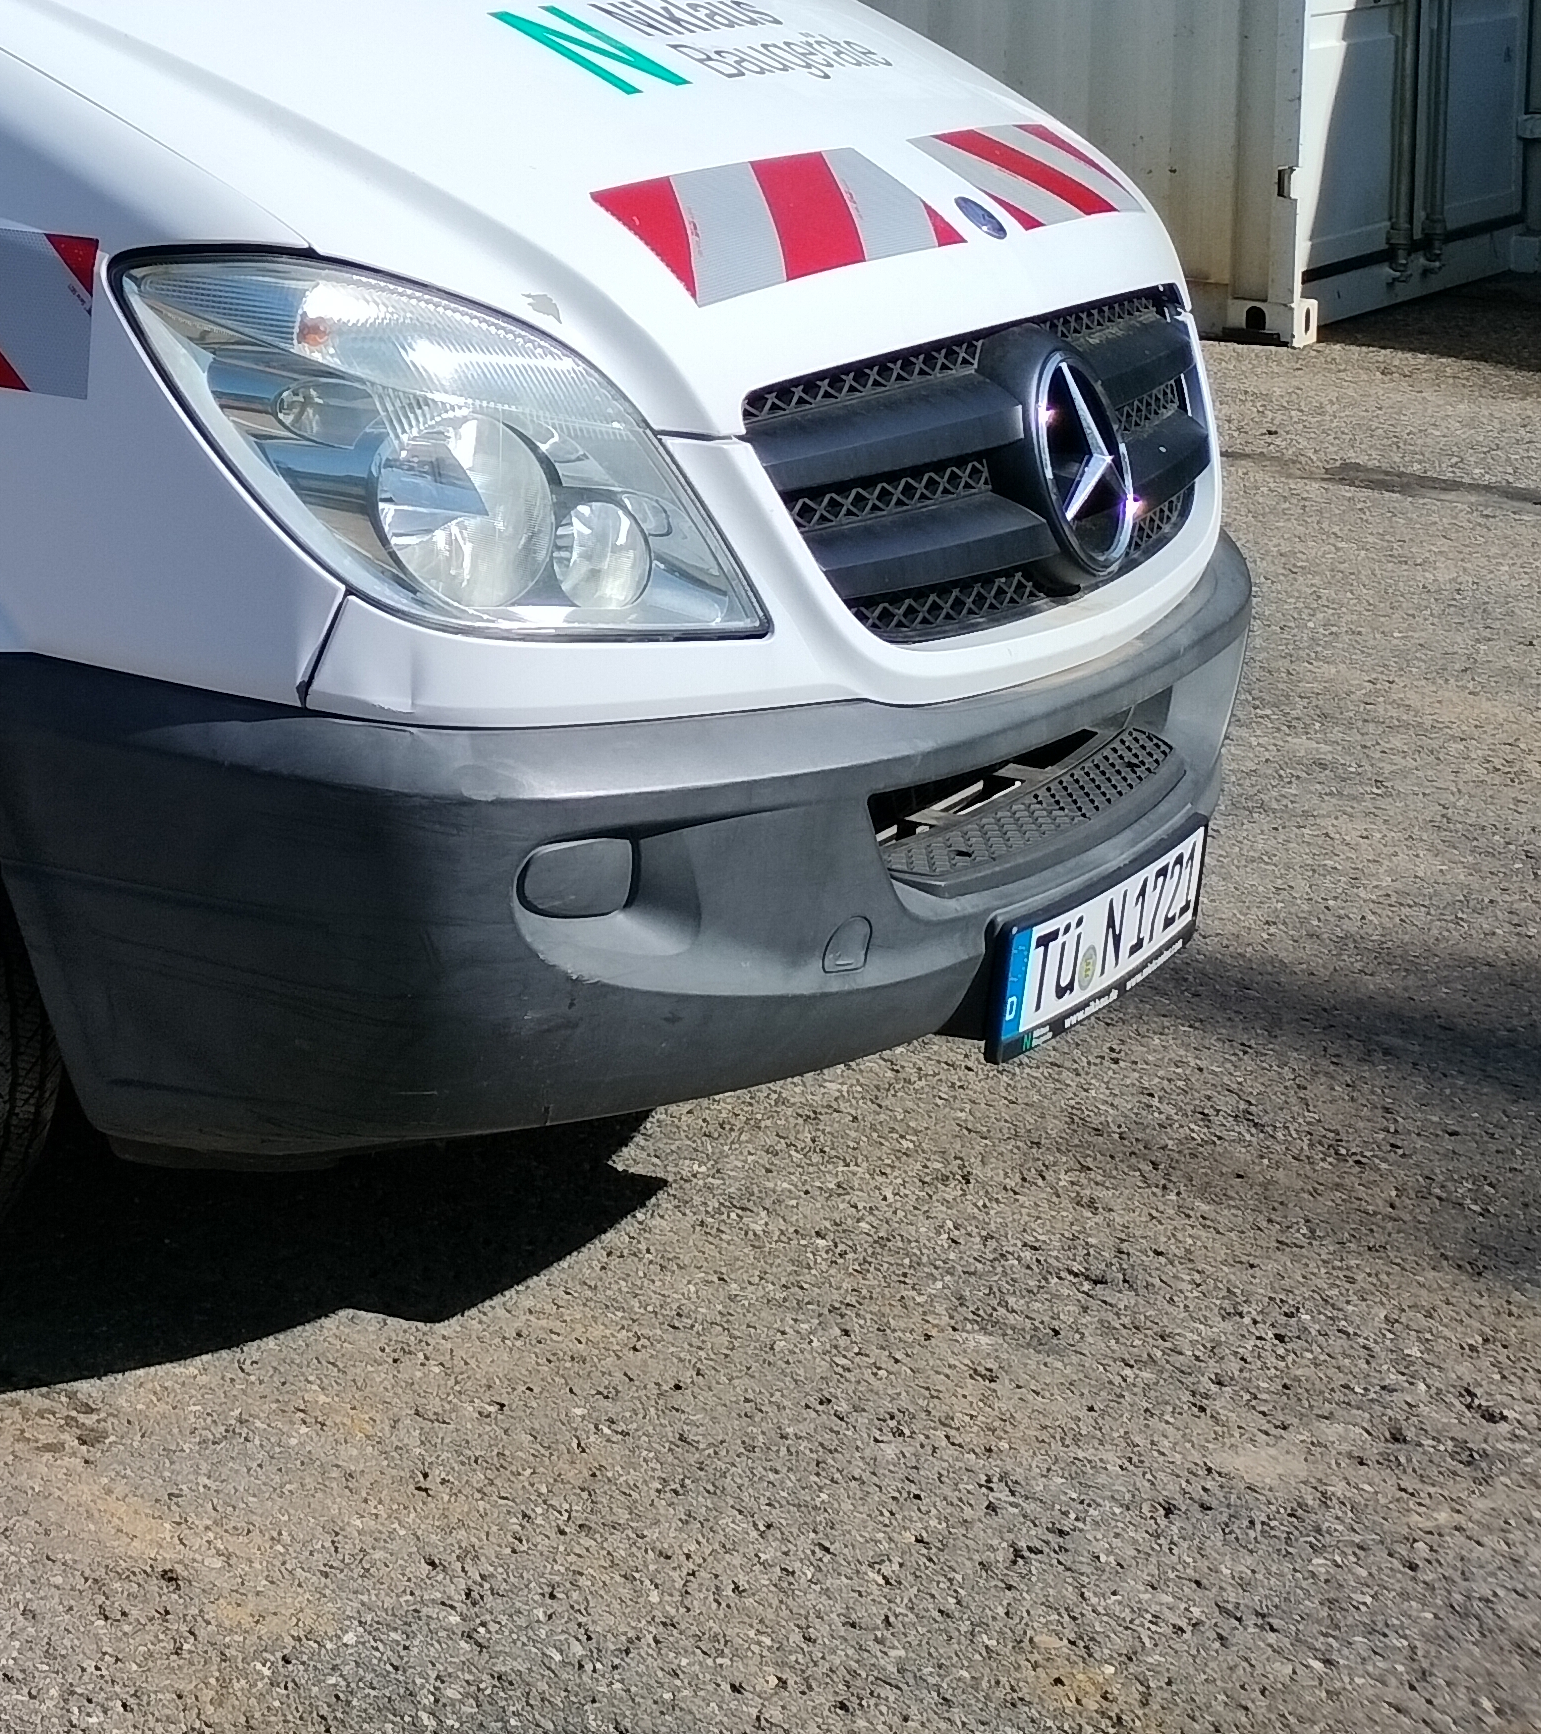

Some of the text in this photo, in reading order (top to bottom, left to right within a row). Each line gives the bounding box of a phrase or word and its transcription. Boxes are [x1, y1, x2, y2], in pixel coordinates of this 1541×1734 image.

[487, 5, 693, 95] N
[666, 31, 893, 80] Baugeräte
[1005, 996, 1017, 1021] D
[1034, 915, 1084, 1014] TÜ
